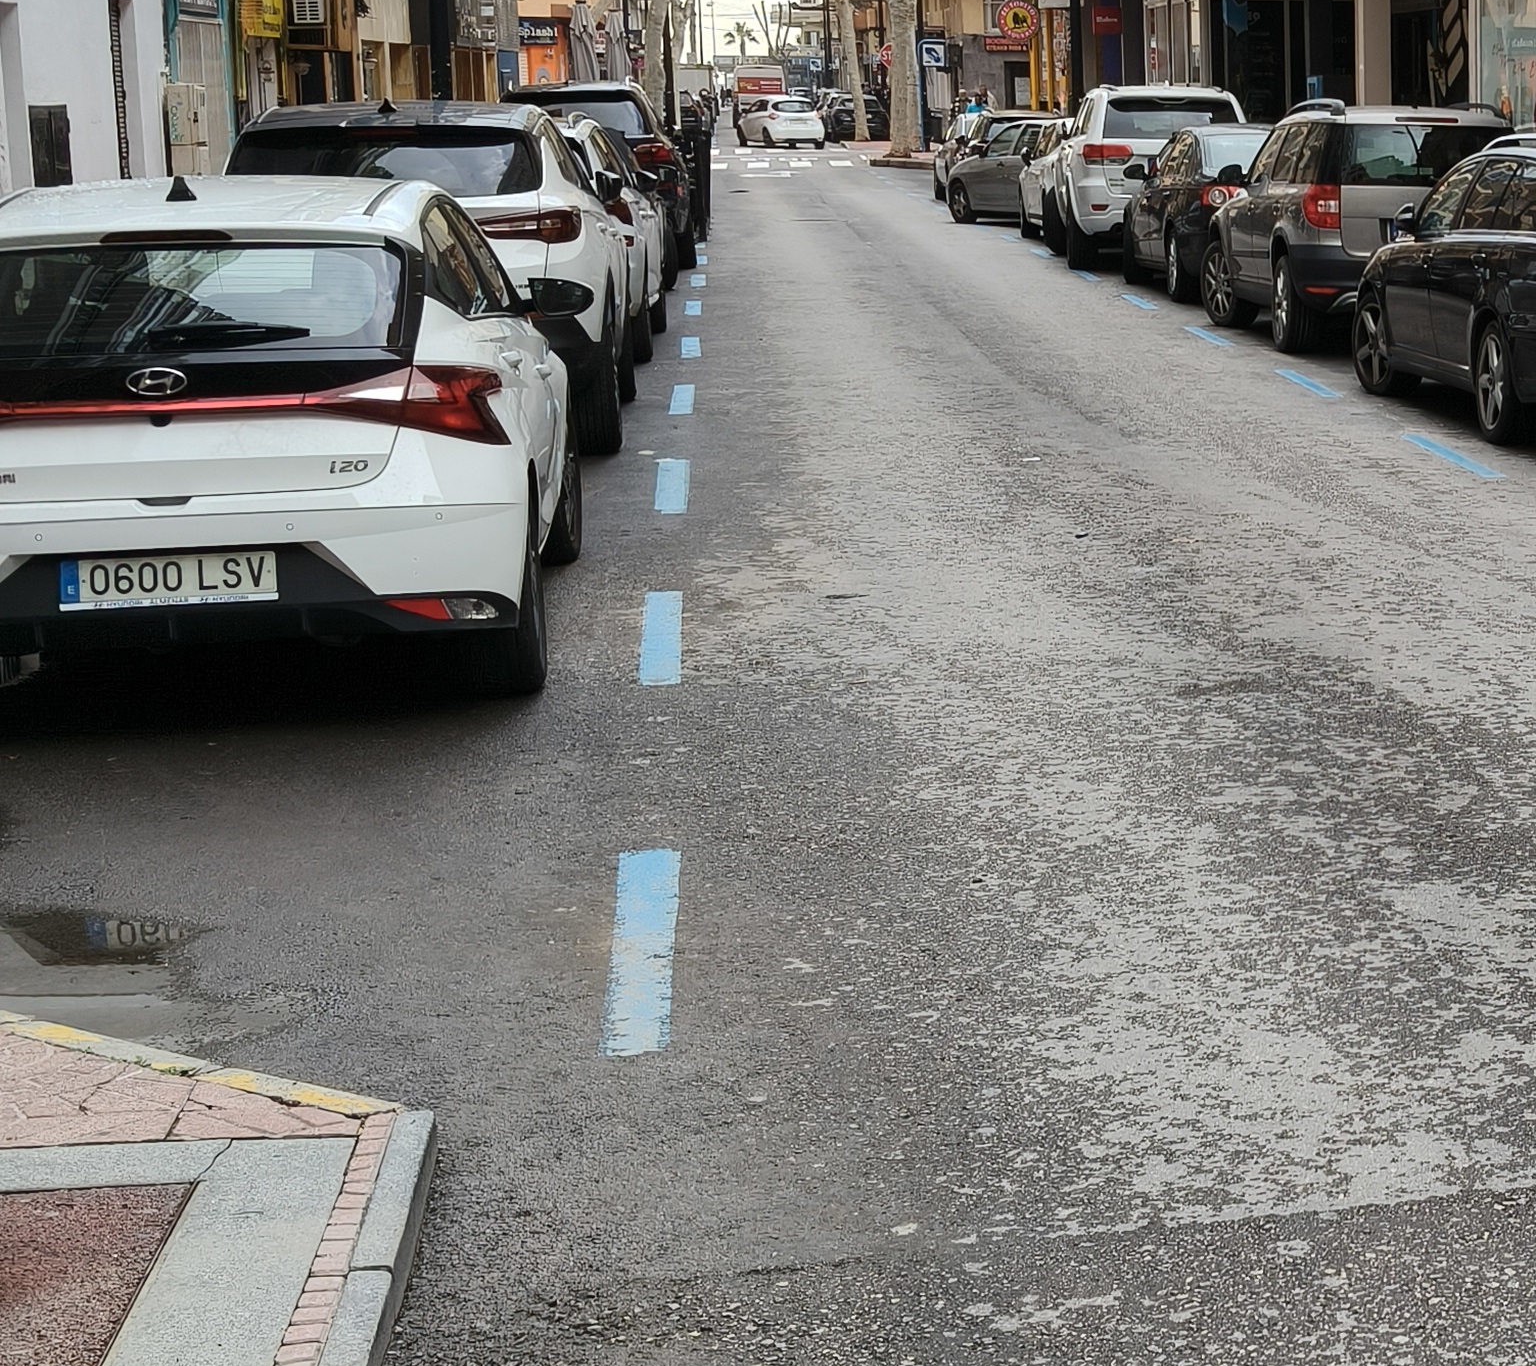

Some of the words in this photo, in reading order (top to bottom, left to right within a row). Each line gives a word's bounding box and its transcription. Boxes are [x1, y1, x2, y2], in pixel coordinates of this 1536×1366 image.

[882, 50, 893, 61] ST
[89, 560, 183, 596] 0600
[198, 555, 265, 591] LSV
